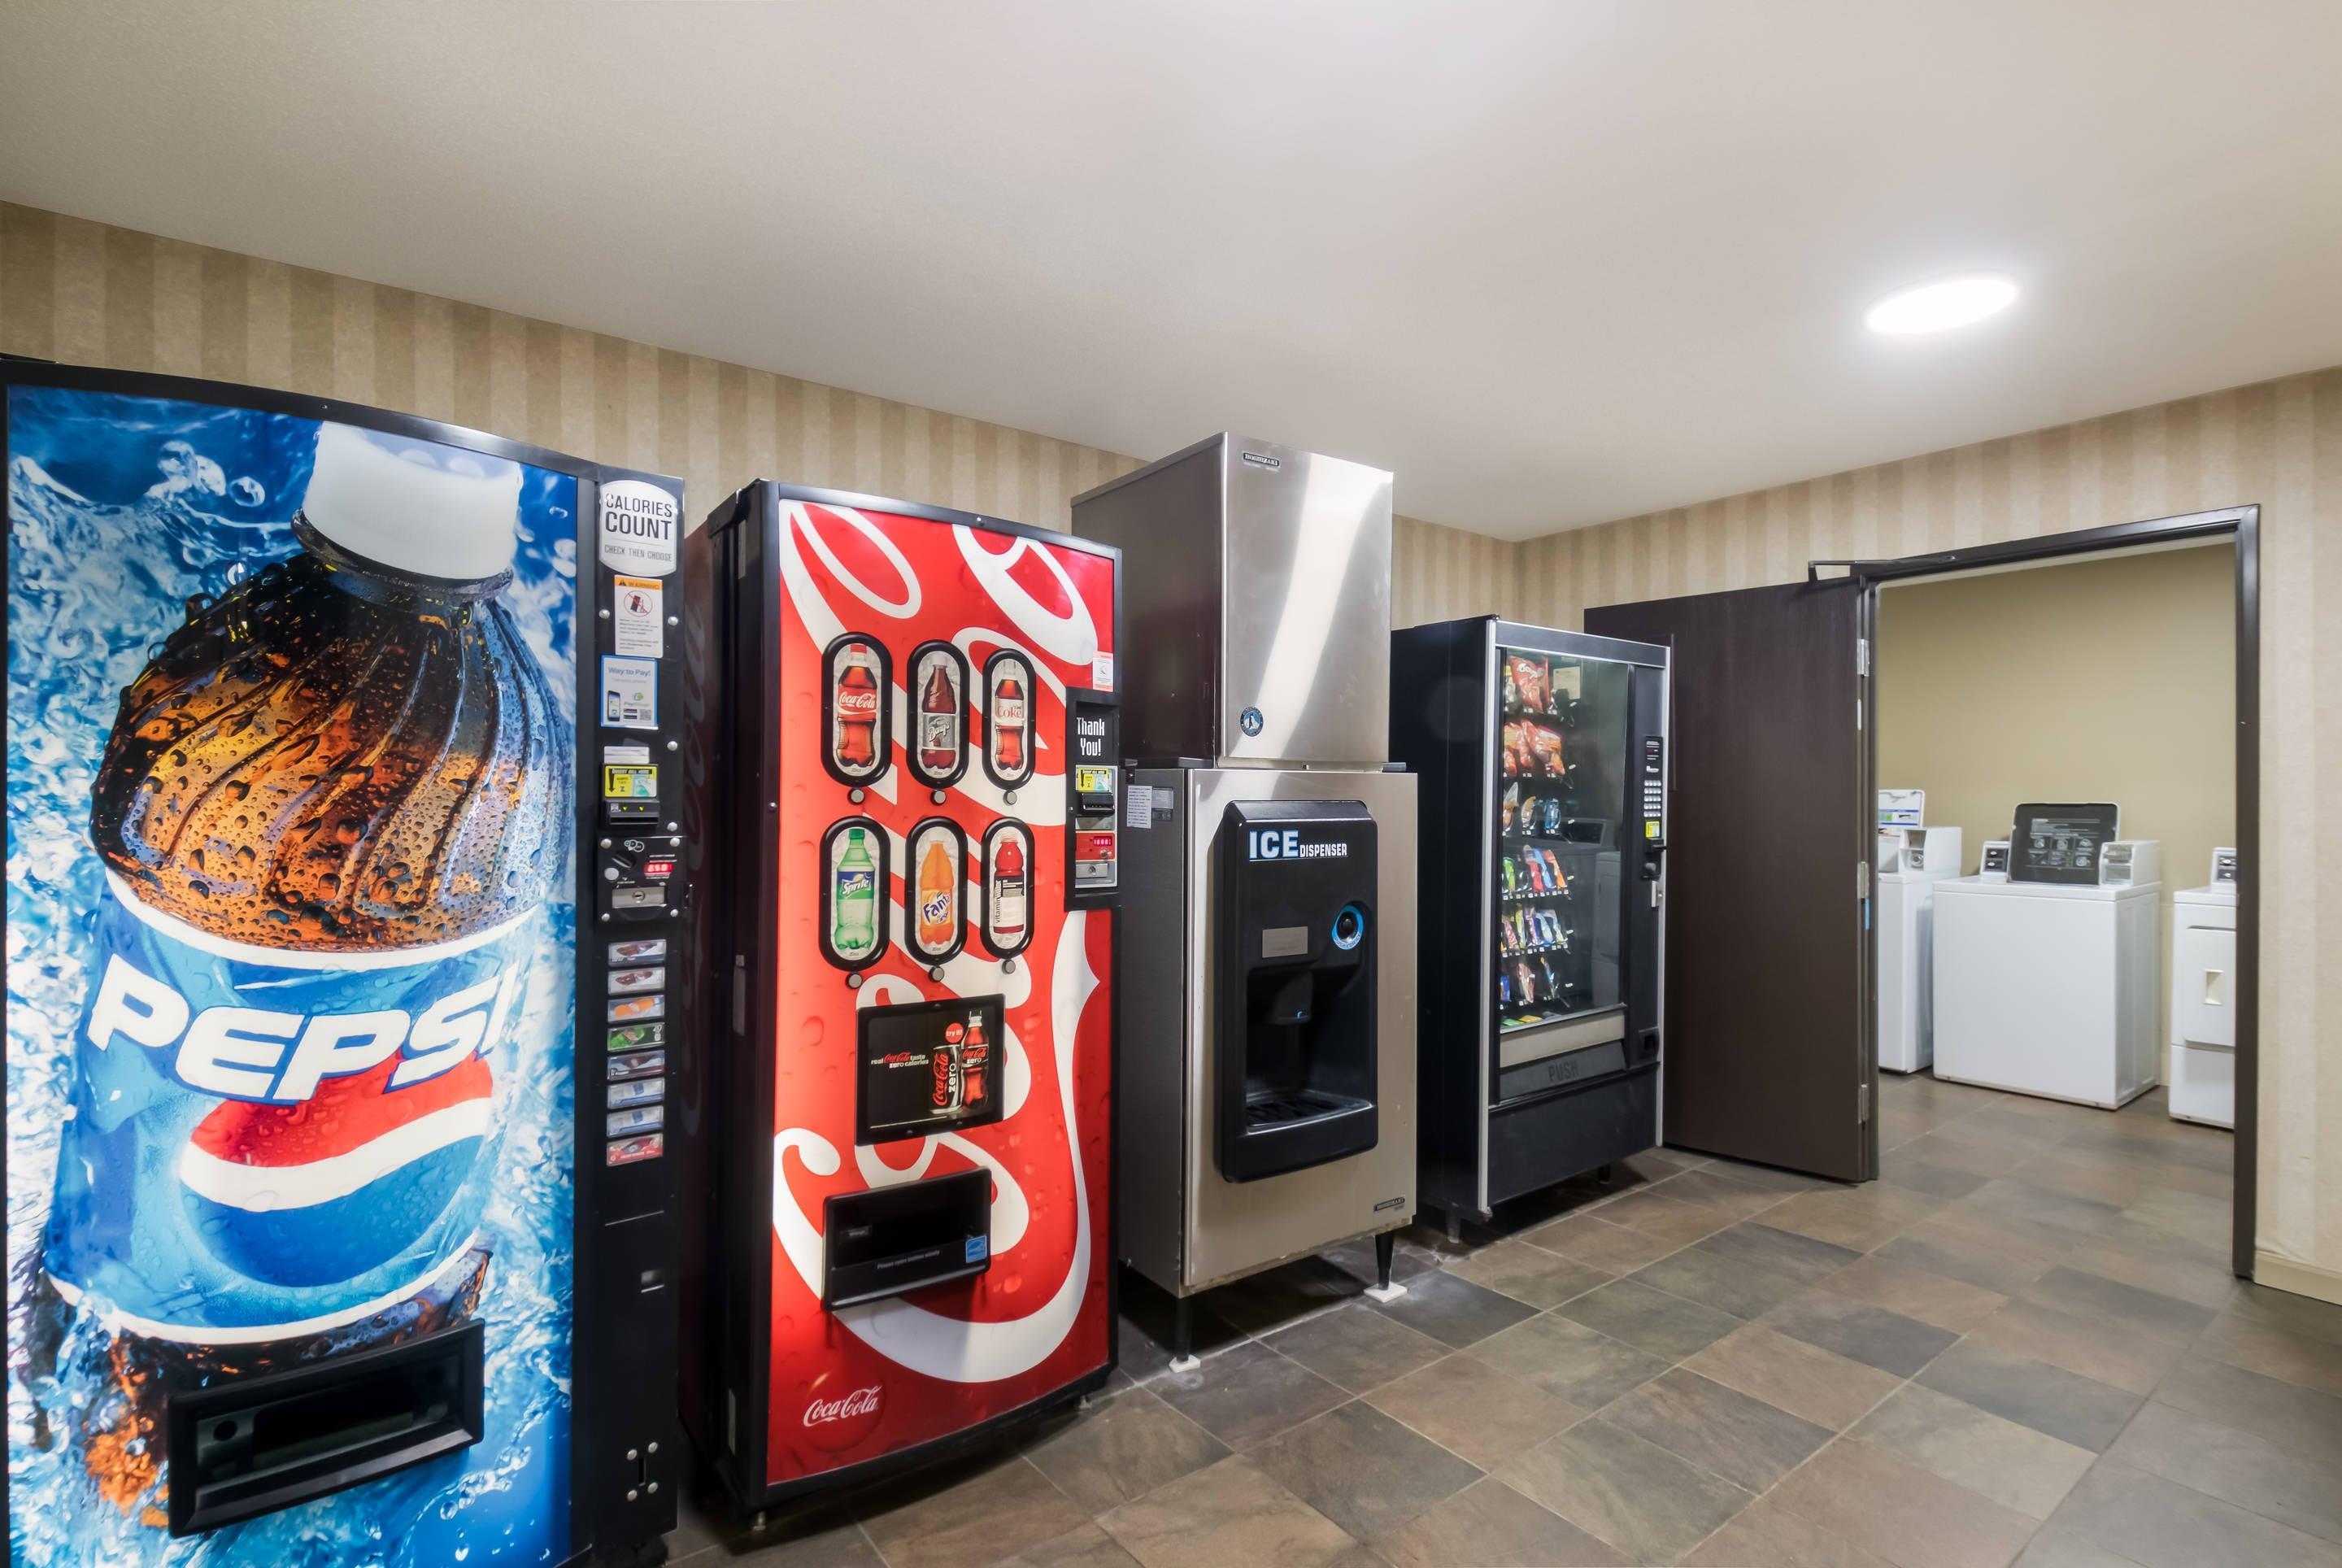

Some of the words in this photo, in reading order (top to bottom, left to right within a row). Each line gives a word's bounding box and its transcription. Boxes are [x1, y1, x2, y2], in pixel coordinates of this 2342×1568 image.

[606, 493, 673, 518] CALORIES
[605, 511, 672, 540] COUNT
[604, 544, 625, 556] CHECK
[629, 547, 645, 558] THEN
[647, 549, 672, 562] CHOOSE
[839, 691, 876, 709] Coca-Cola
[995, 705, 1021, 718] Coke
[1077, 717, 1105, 736] Thank
[1080, 738, 1101, 756] You!
[1249, 830, 1299, 859] ICE
[1299, 843, 1347, 857] DISPENSER
[842, 878, 871, 895] Sprite
[923, 895, 950, 923] Fanta
[86, 953, 519, 1101] PEPSI
[904, 1059, 929, 1067] calories
[1548, 1061, 1579, 1082] PUSH
[948, 1063, 956, 1093] zero
[803, 1384, 882, 1427] Coca-Cola
